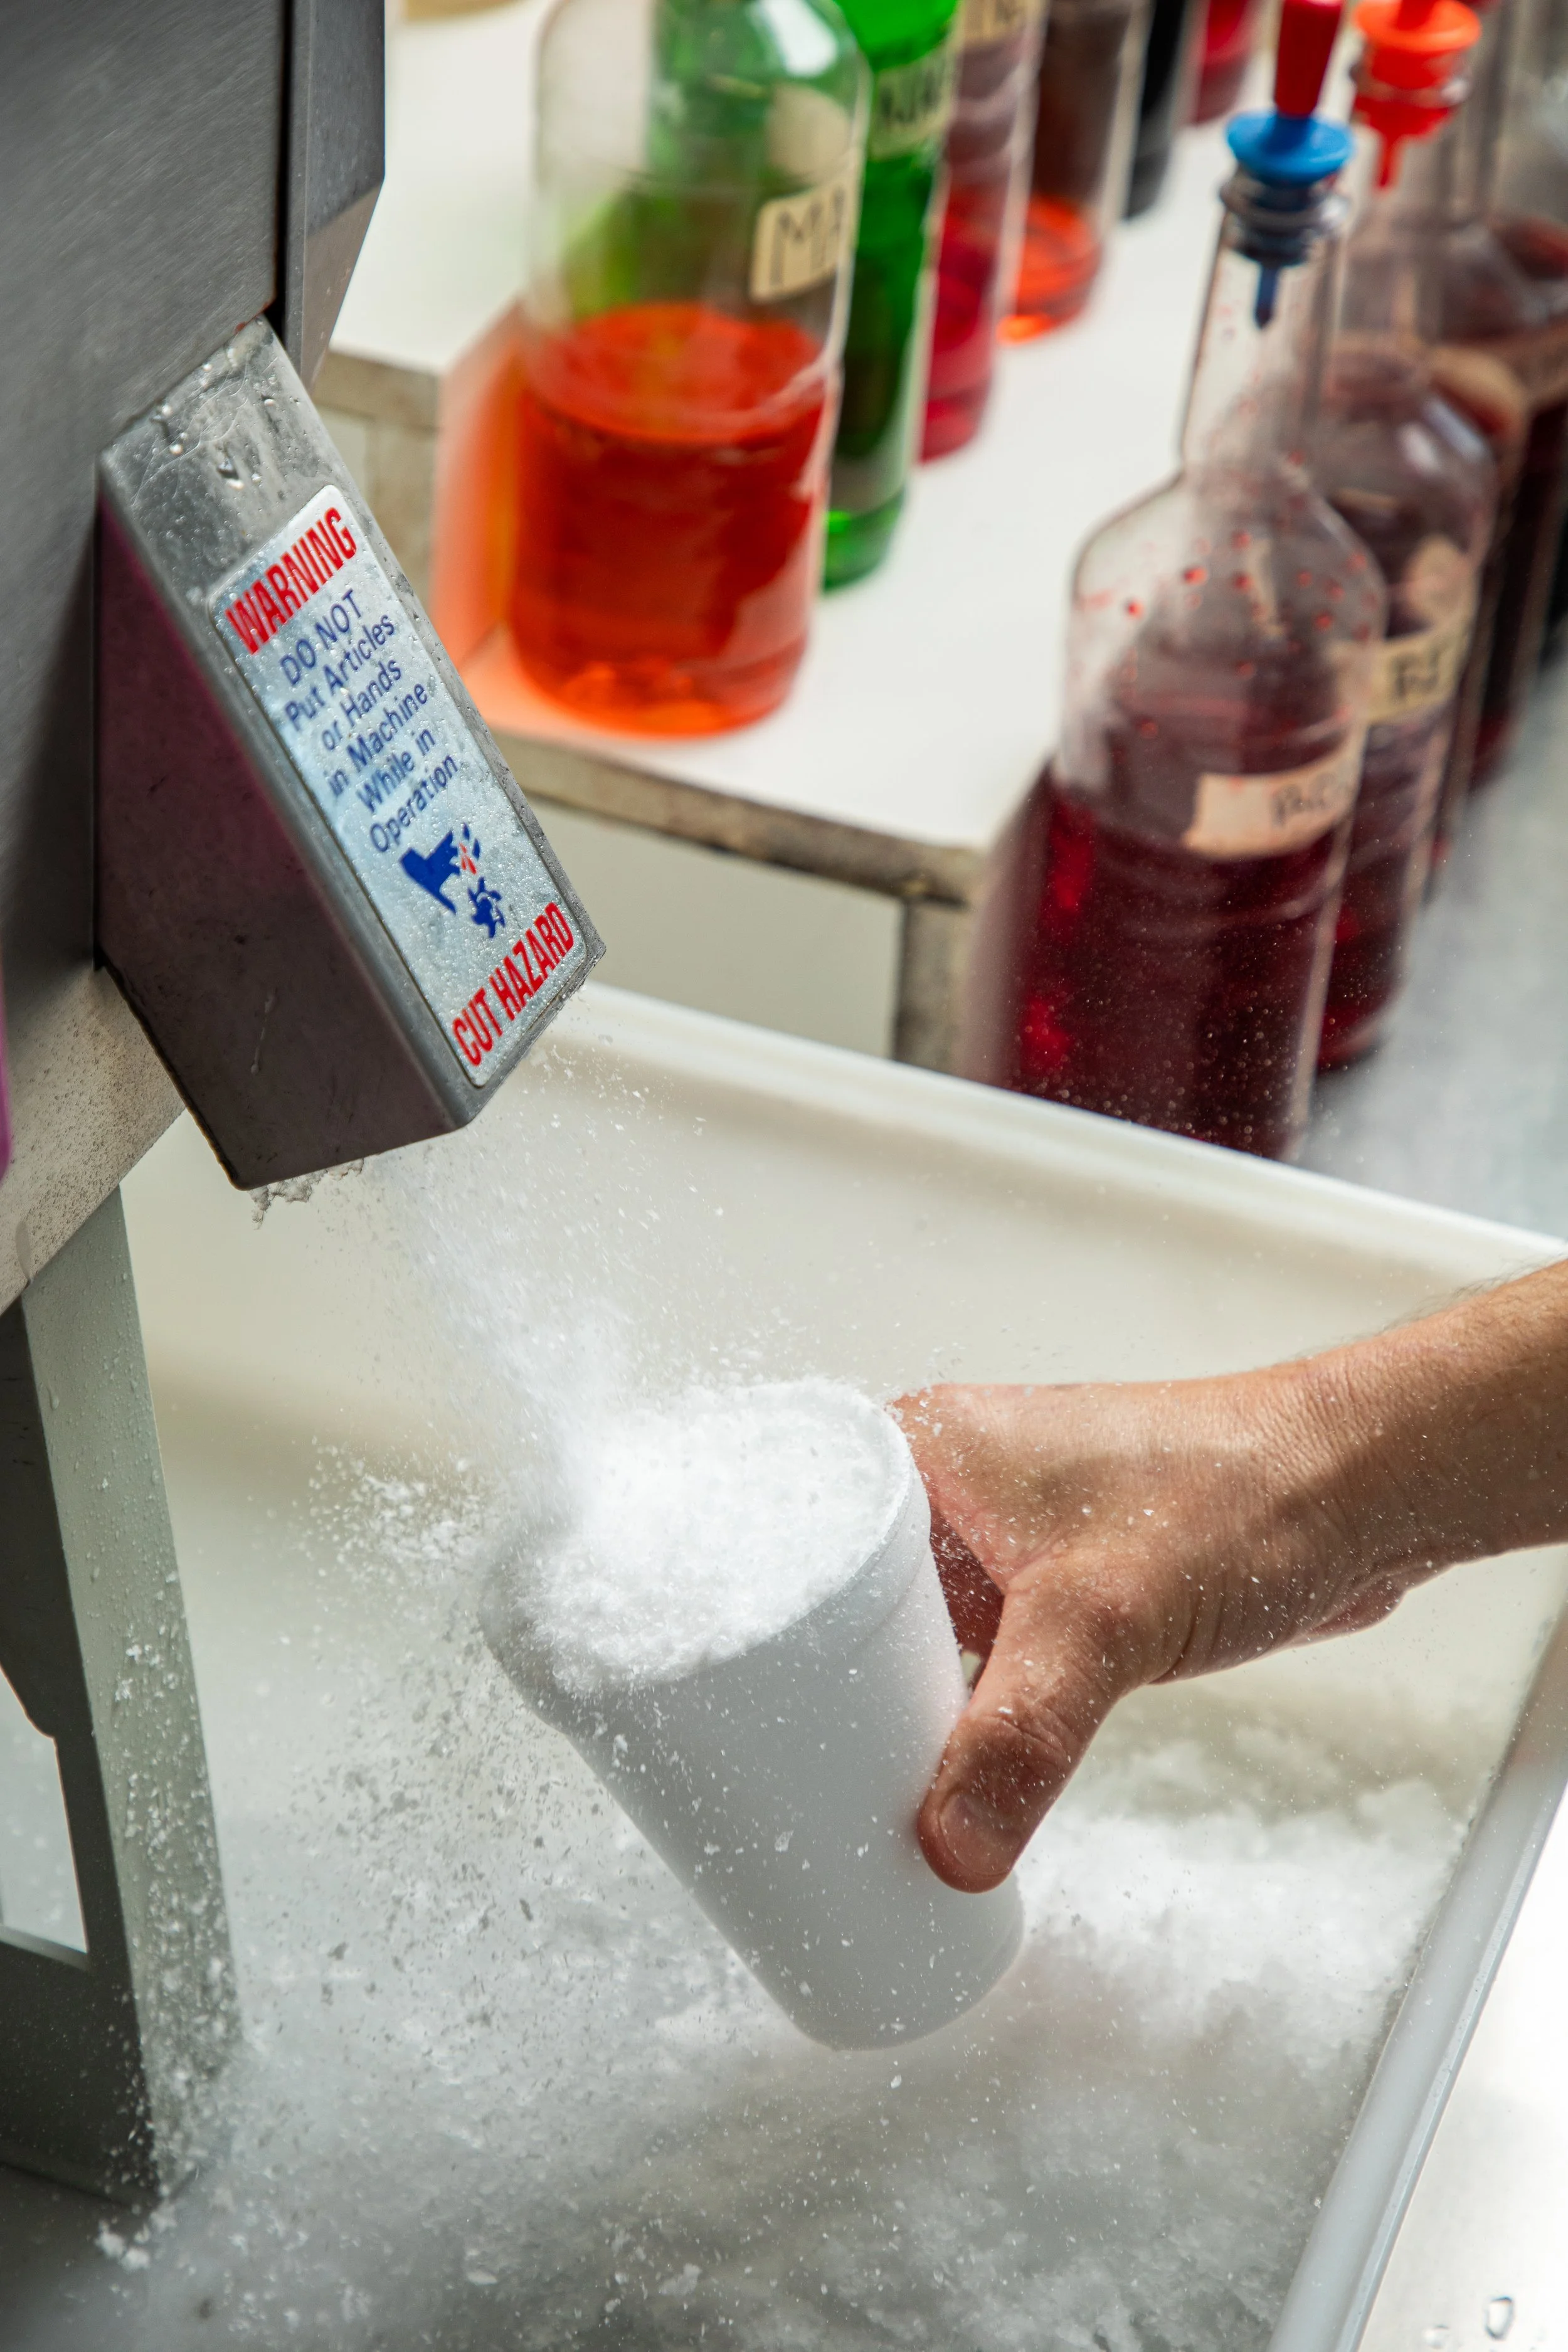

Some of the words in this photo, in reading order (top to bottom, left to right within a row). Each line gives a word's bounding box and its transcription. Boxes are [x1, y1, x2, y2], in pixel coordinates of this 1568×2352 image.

[225, 507, 356, 655] WARNING
[280, 638, 316, 686] DO
[315, 588, 362, 650] NOT
[285, 685, 326, 732] Put
[322, 615, 395, 696] Articles
[322, 720, 342, 751] or
[339, 659, 401, 728] Hands
[323, 769, 349, 797] in
[347, 683, 428, 772] Machine
[356, 751, 415, 813] While
[411, 729, 435, 755] in
[370, 755, 458, 853] Operation
[452, 987, 504, 1066] CUT
[489, 902, 574, 1021] HAZARD
